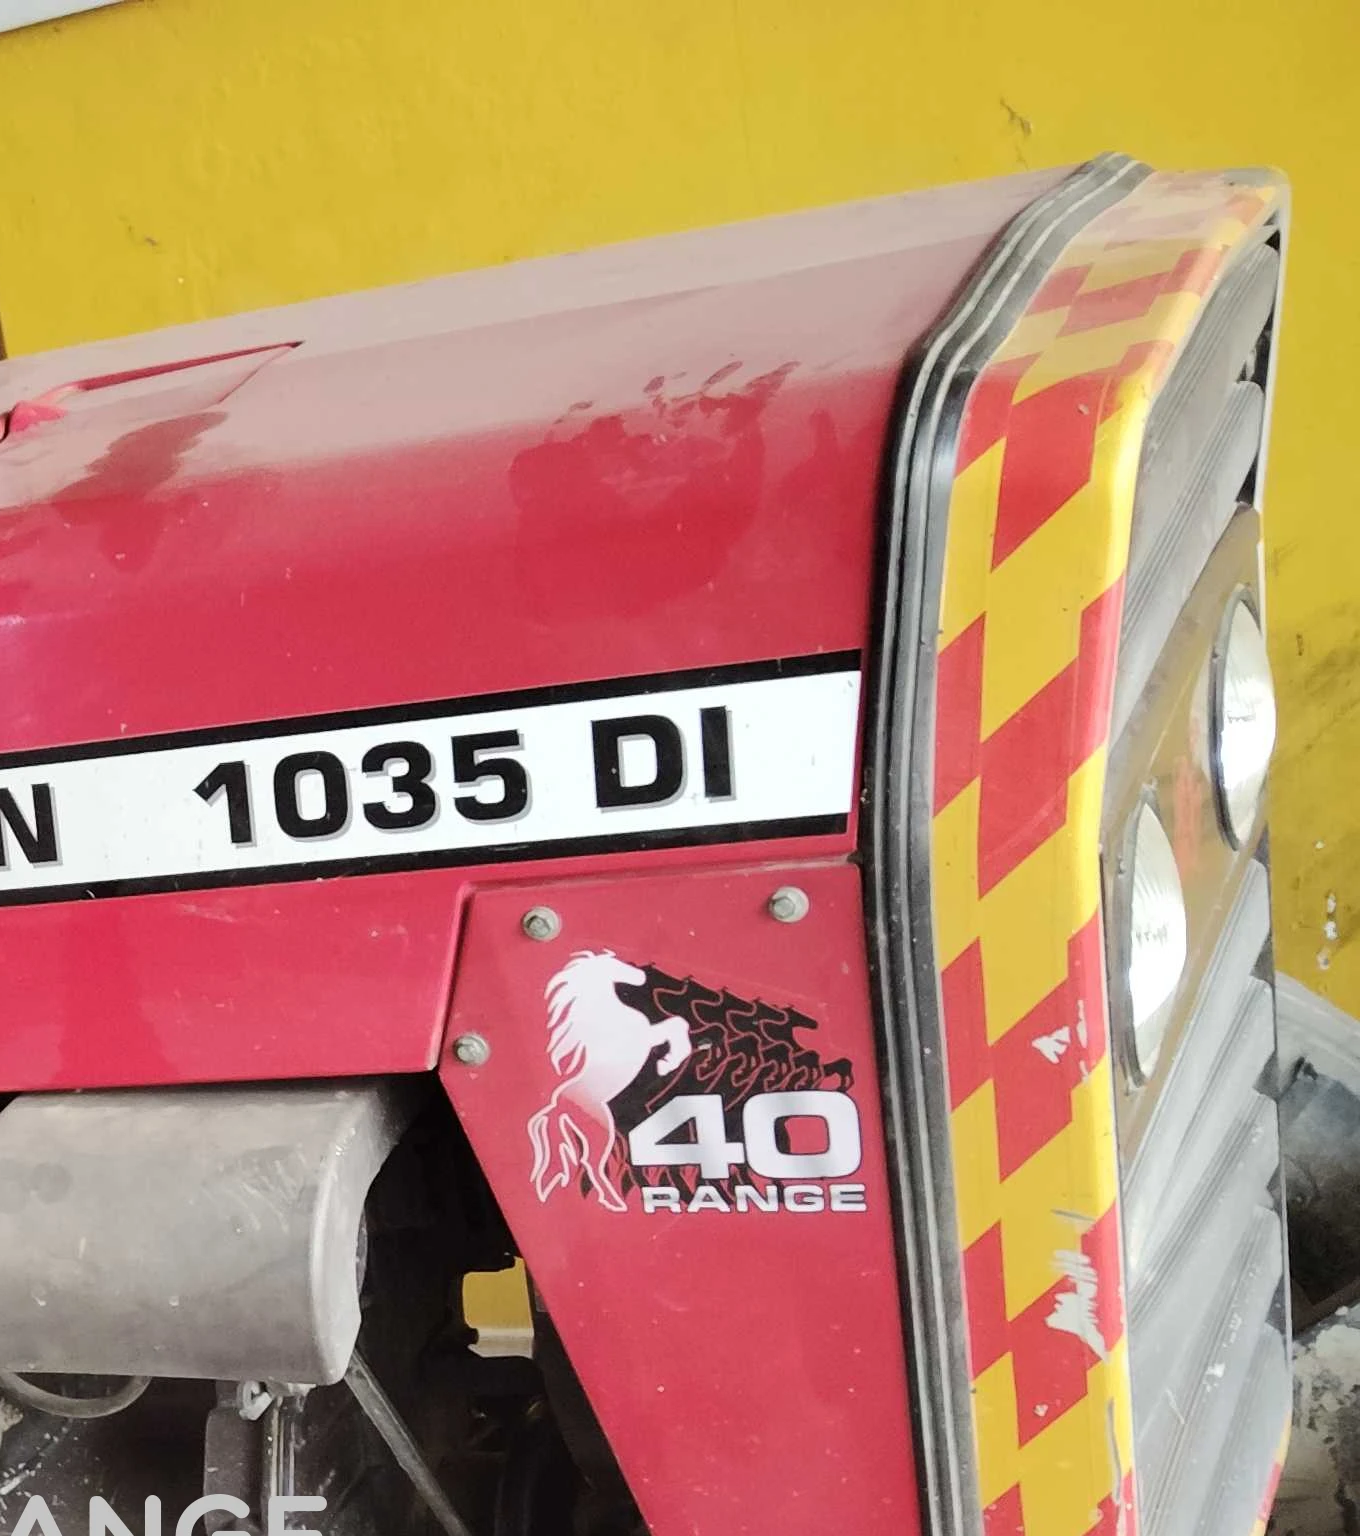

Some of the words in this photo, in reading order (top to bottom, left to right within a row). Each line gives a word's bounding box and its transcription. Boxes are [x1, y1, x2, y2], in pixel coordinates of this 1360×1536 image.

[193, 728, 531, 848] 1035
[590, 706, 738, 811] DI
[628, 1089, 864, 1181] 40
[642, 1183, 868, 1215] RANGE
